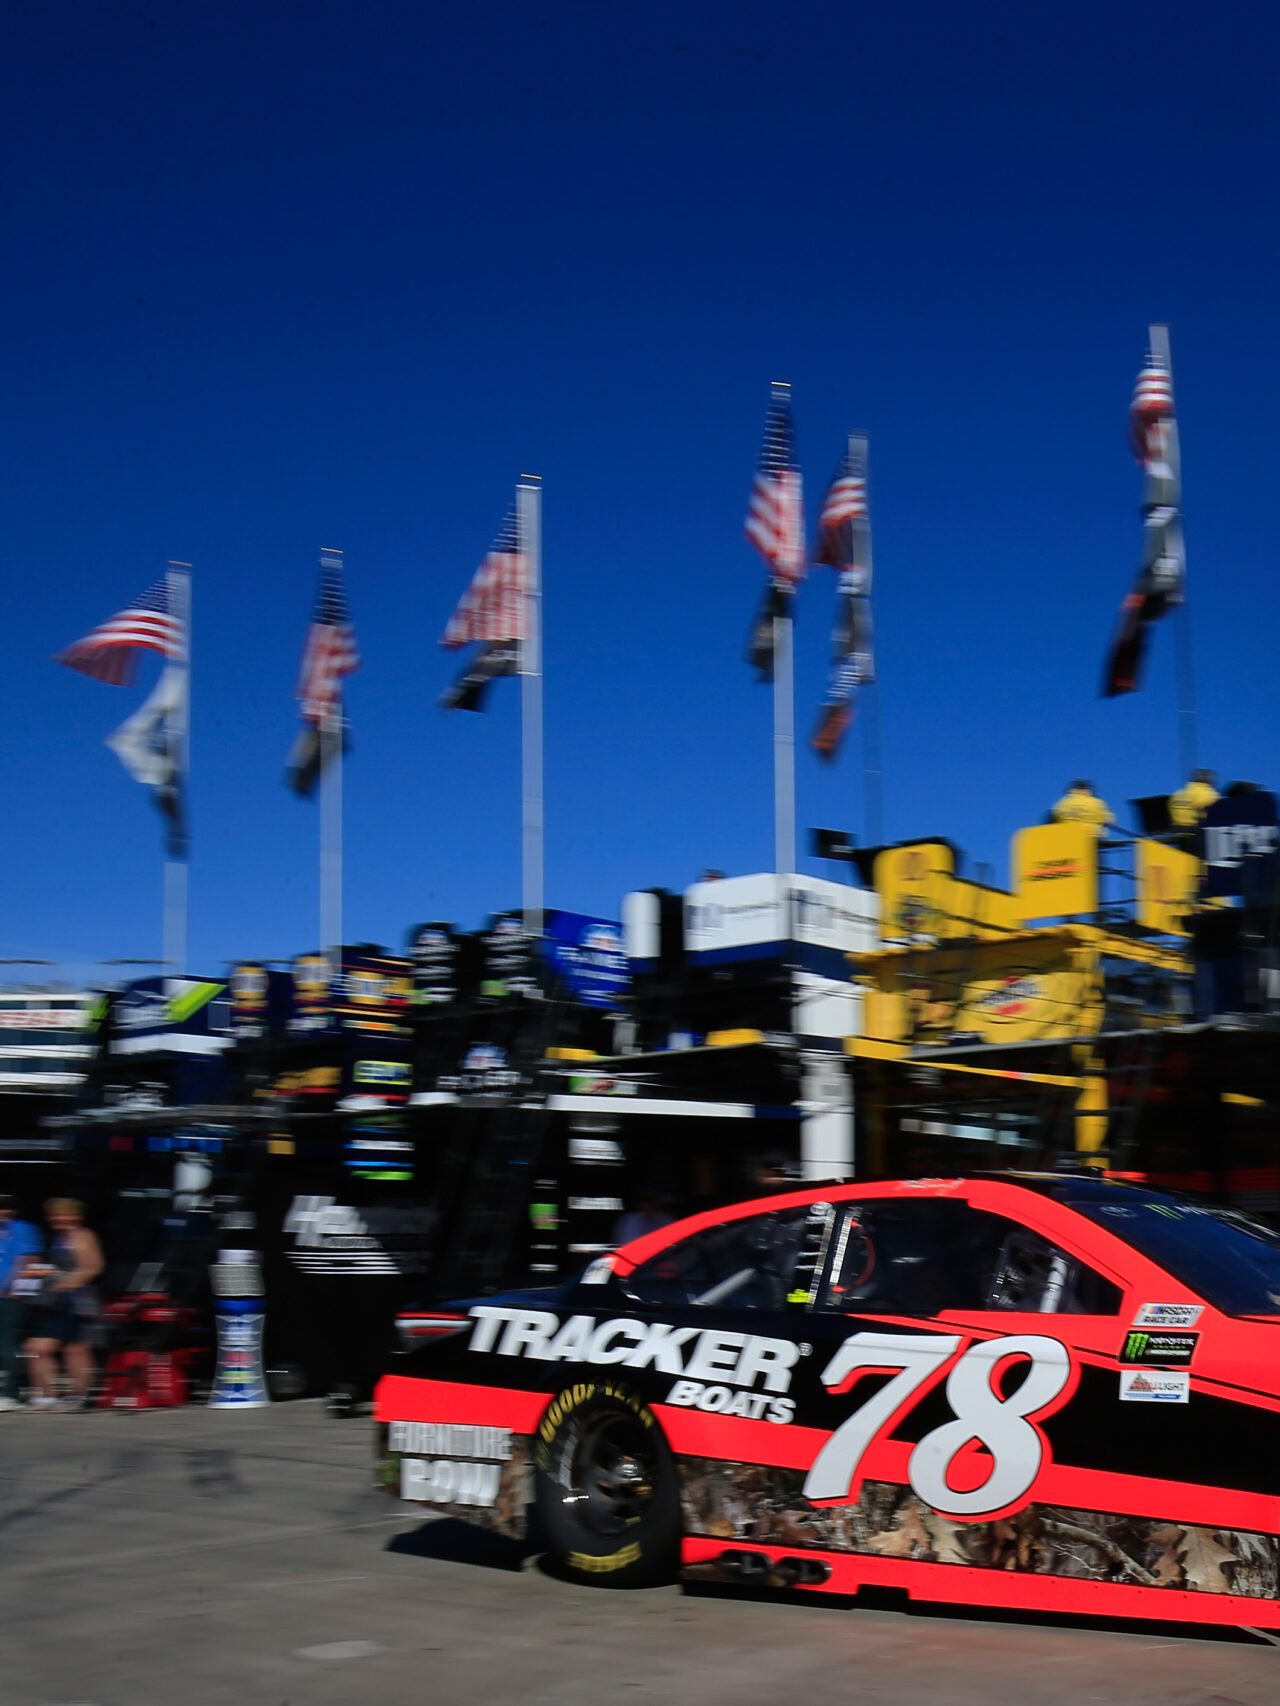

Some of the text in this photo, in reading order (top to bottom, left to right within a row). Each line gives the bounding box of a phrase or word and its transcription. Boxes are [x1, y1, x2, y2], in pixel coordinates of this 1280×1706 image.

[468, 1305, 800, 1394] TRACKER
[664, 1379, 797, 1425] BOATS
[802, 1332, 1073, 1516] 78
